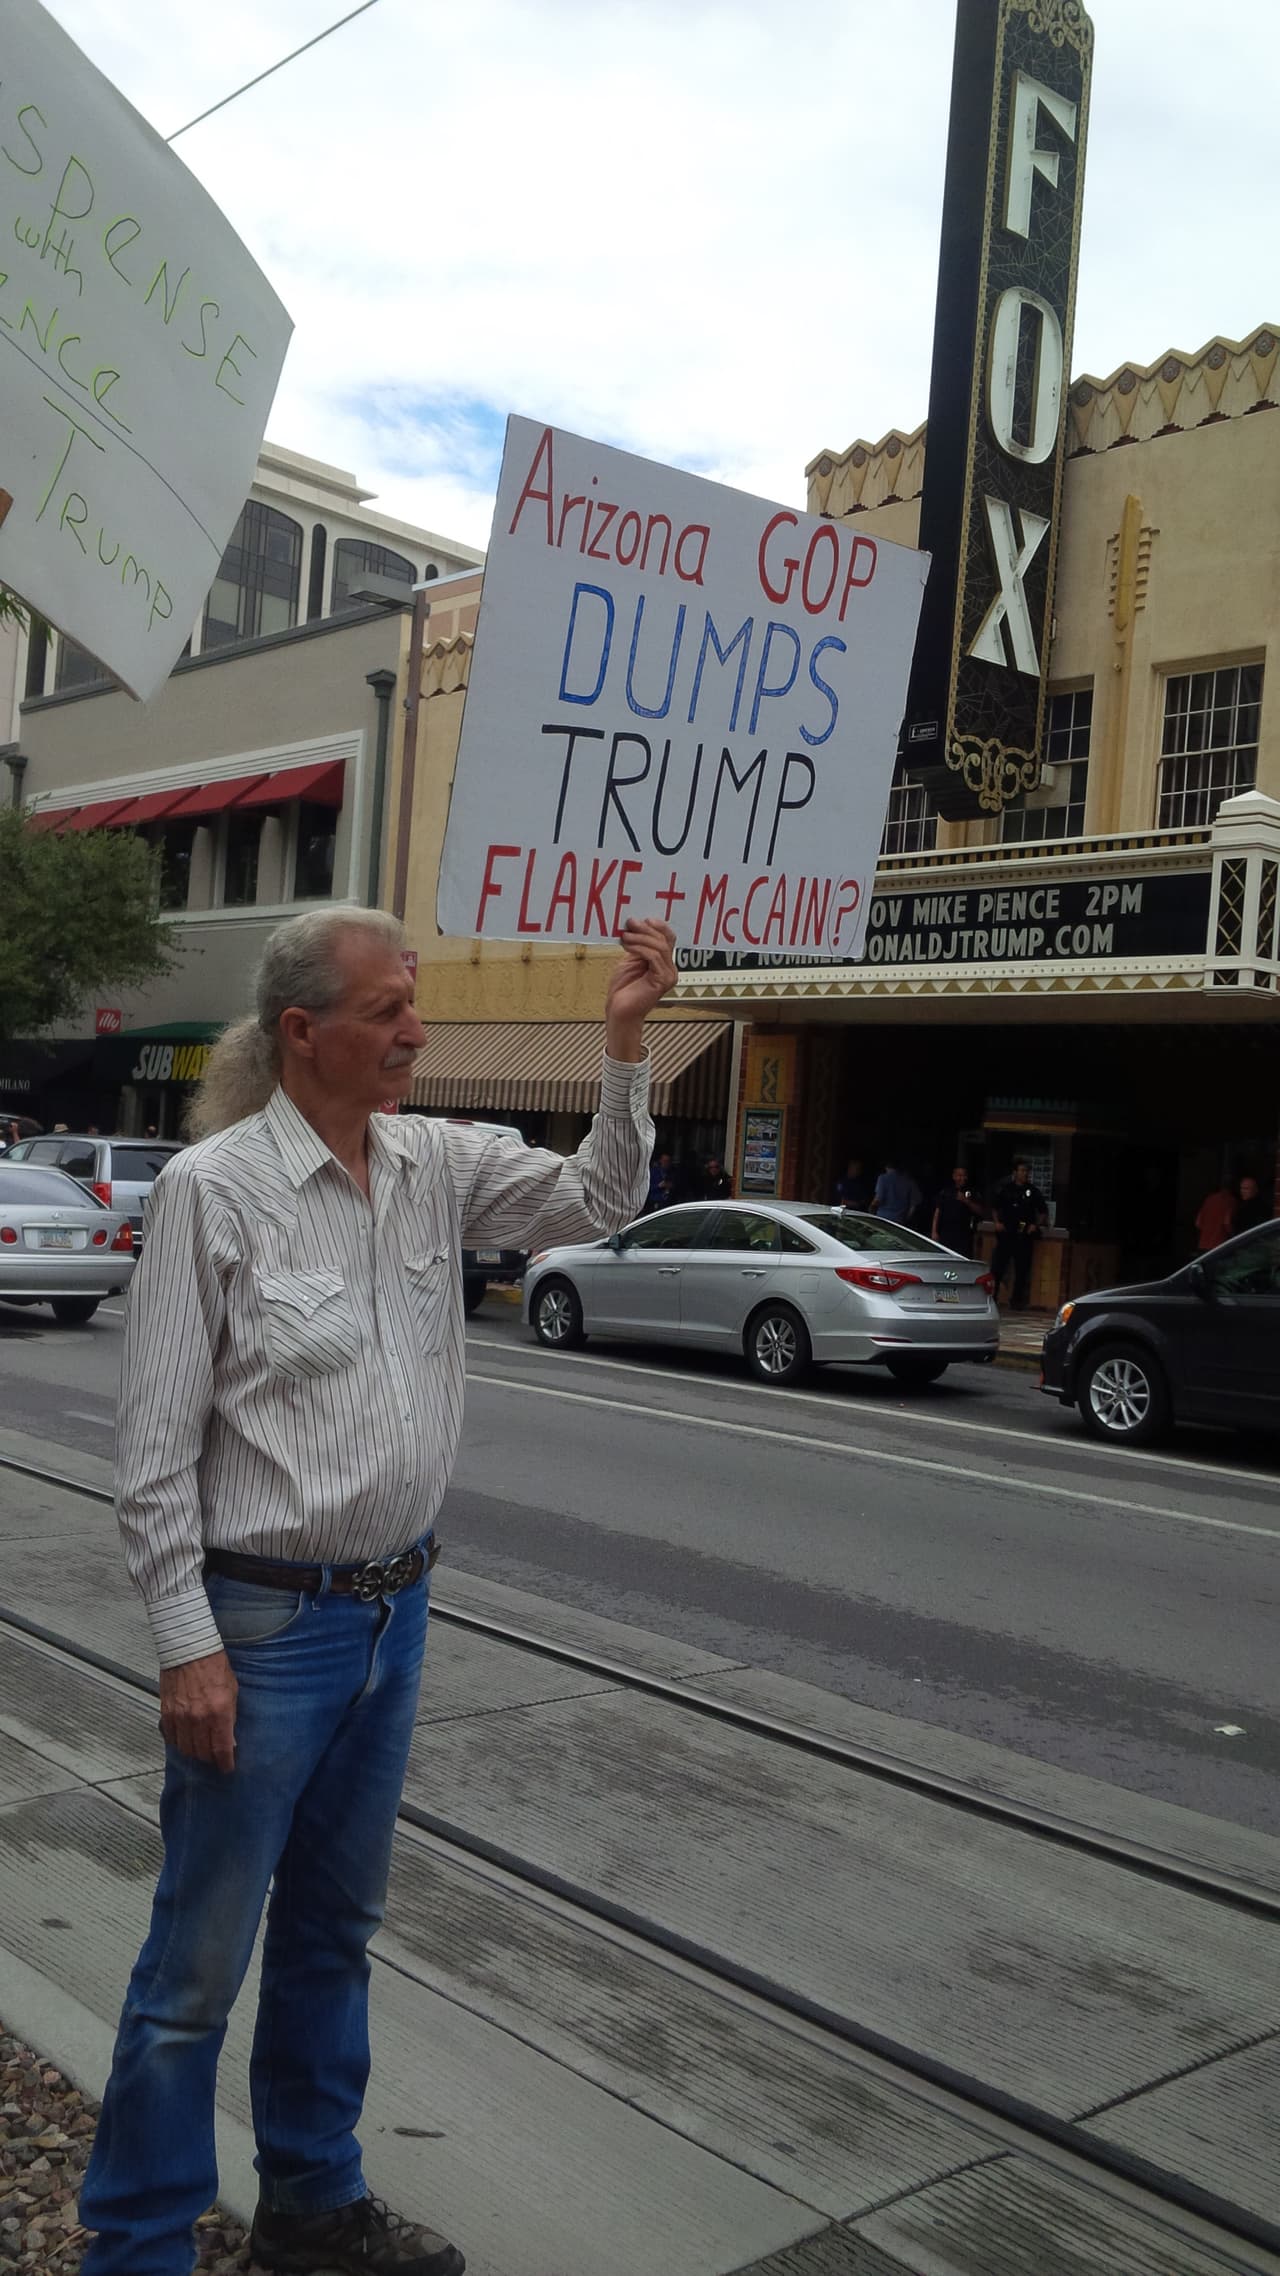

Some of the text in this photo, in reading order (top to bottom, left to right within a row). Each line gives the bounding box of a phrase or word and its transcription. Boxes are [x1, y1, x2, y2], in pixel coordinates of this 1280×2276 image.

[967, 68, 1077, 678] FOX
[509, 428, 878, 622] Arizona GOP
[558, 582, 848, 746] DUMPS
[541, 724, 816, 866] TRUMP
[475, 845, 643, 938] FLAKE
[868, 883, 1143, 928] OV MIKE PENCE 2PM
[677, 948, 715, 969] GOP
[98, 1012, 120, 1032] illy
